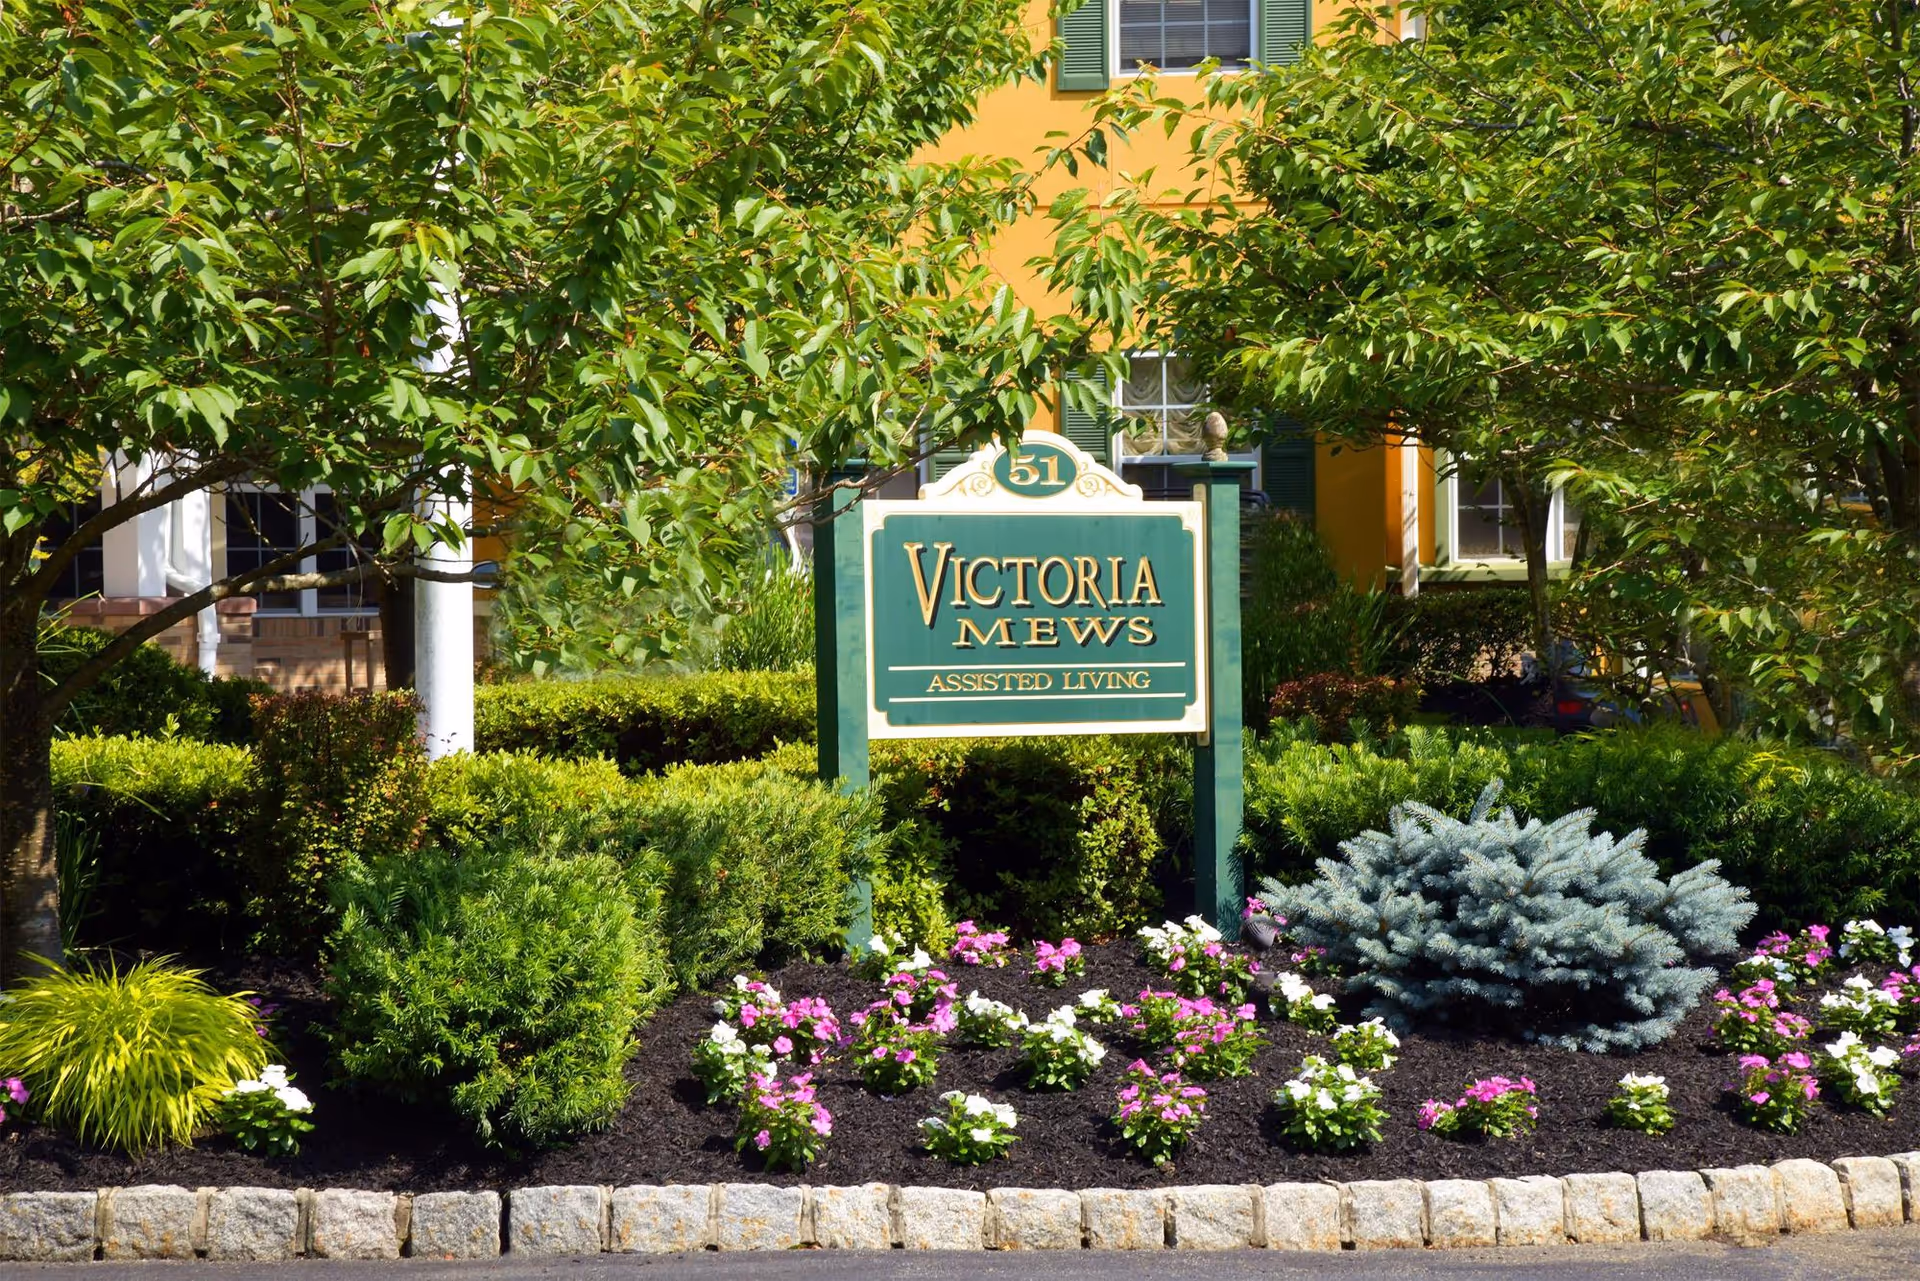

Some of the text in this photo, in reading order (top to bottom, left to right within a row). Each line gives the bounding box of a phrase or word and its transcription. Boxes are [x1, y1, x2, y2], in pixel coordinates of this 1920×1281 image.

[1008, 454, 1067, 487] 51
[903, 541, 1163, 627] VICTORIA
[952, 615, 1156, 647] MEWS
[926, 670, 1151, 692] ASSISTED LIVING
